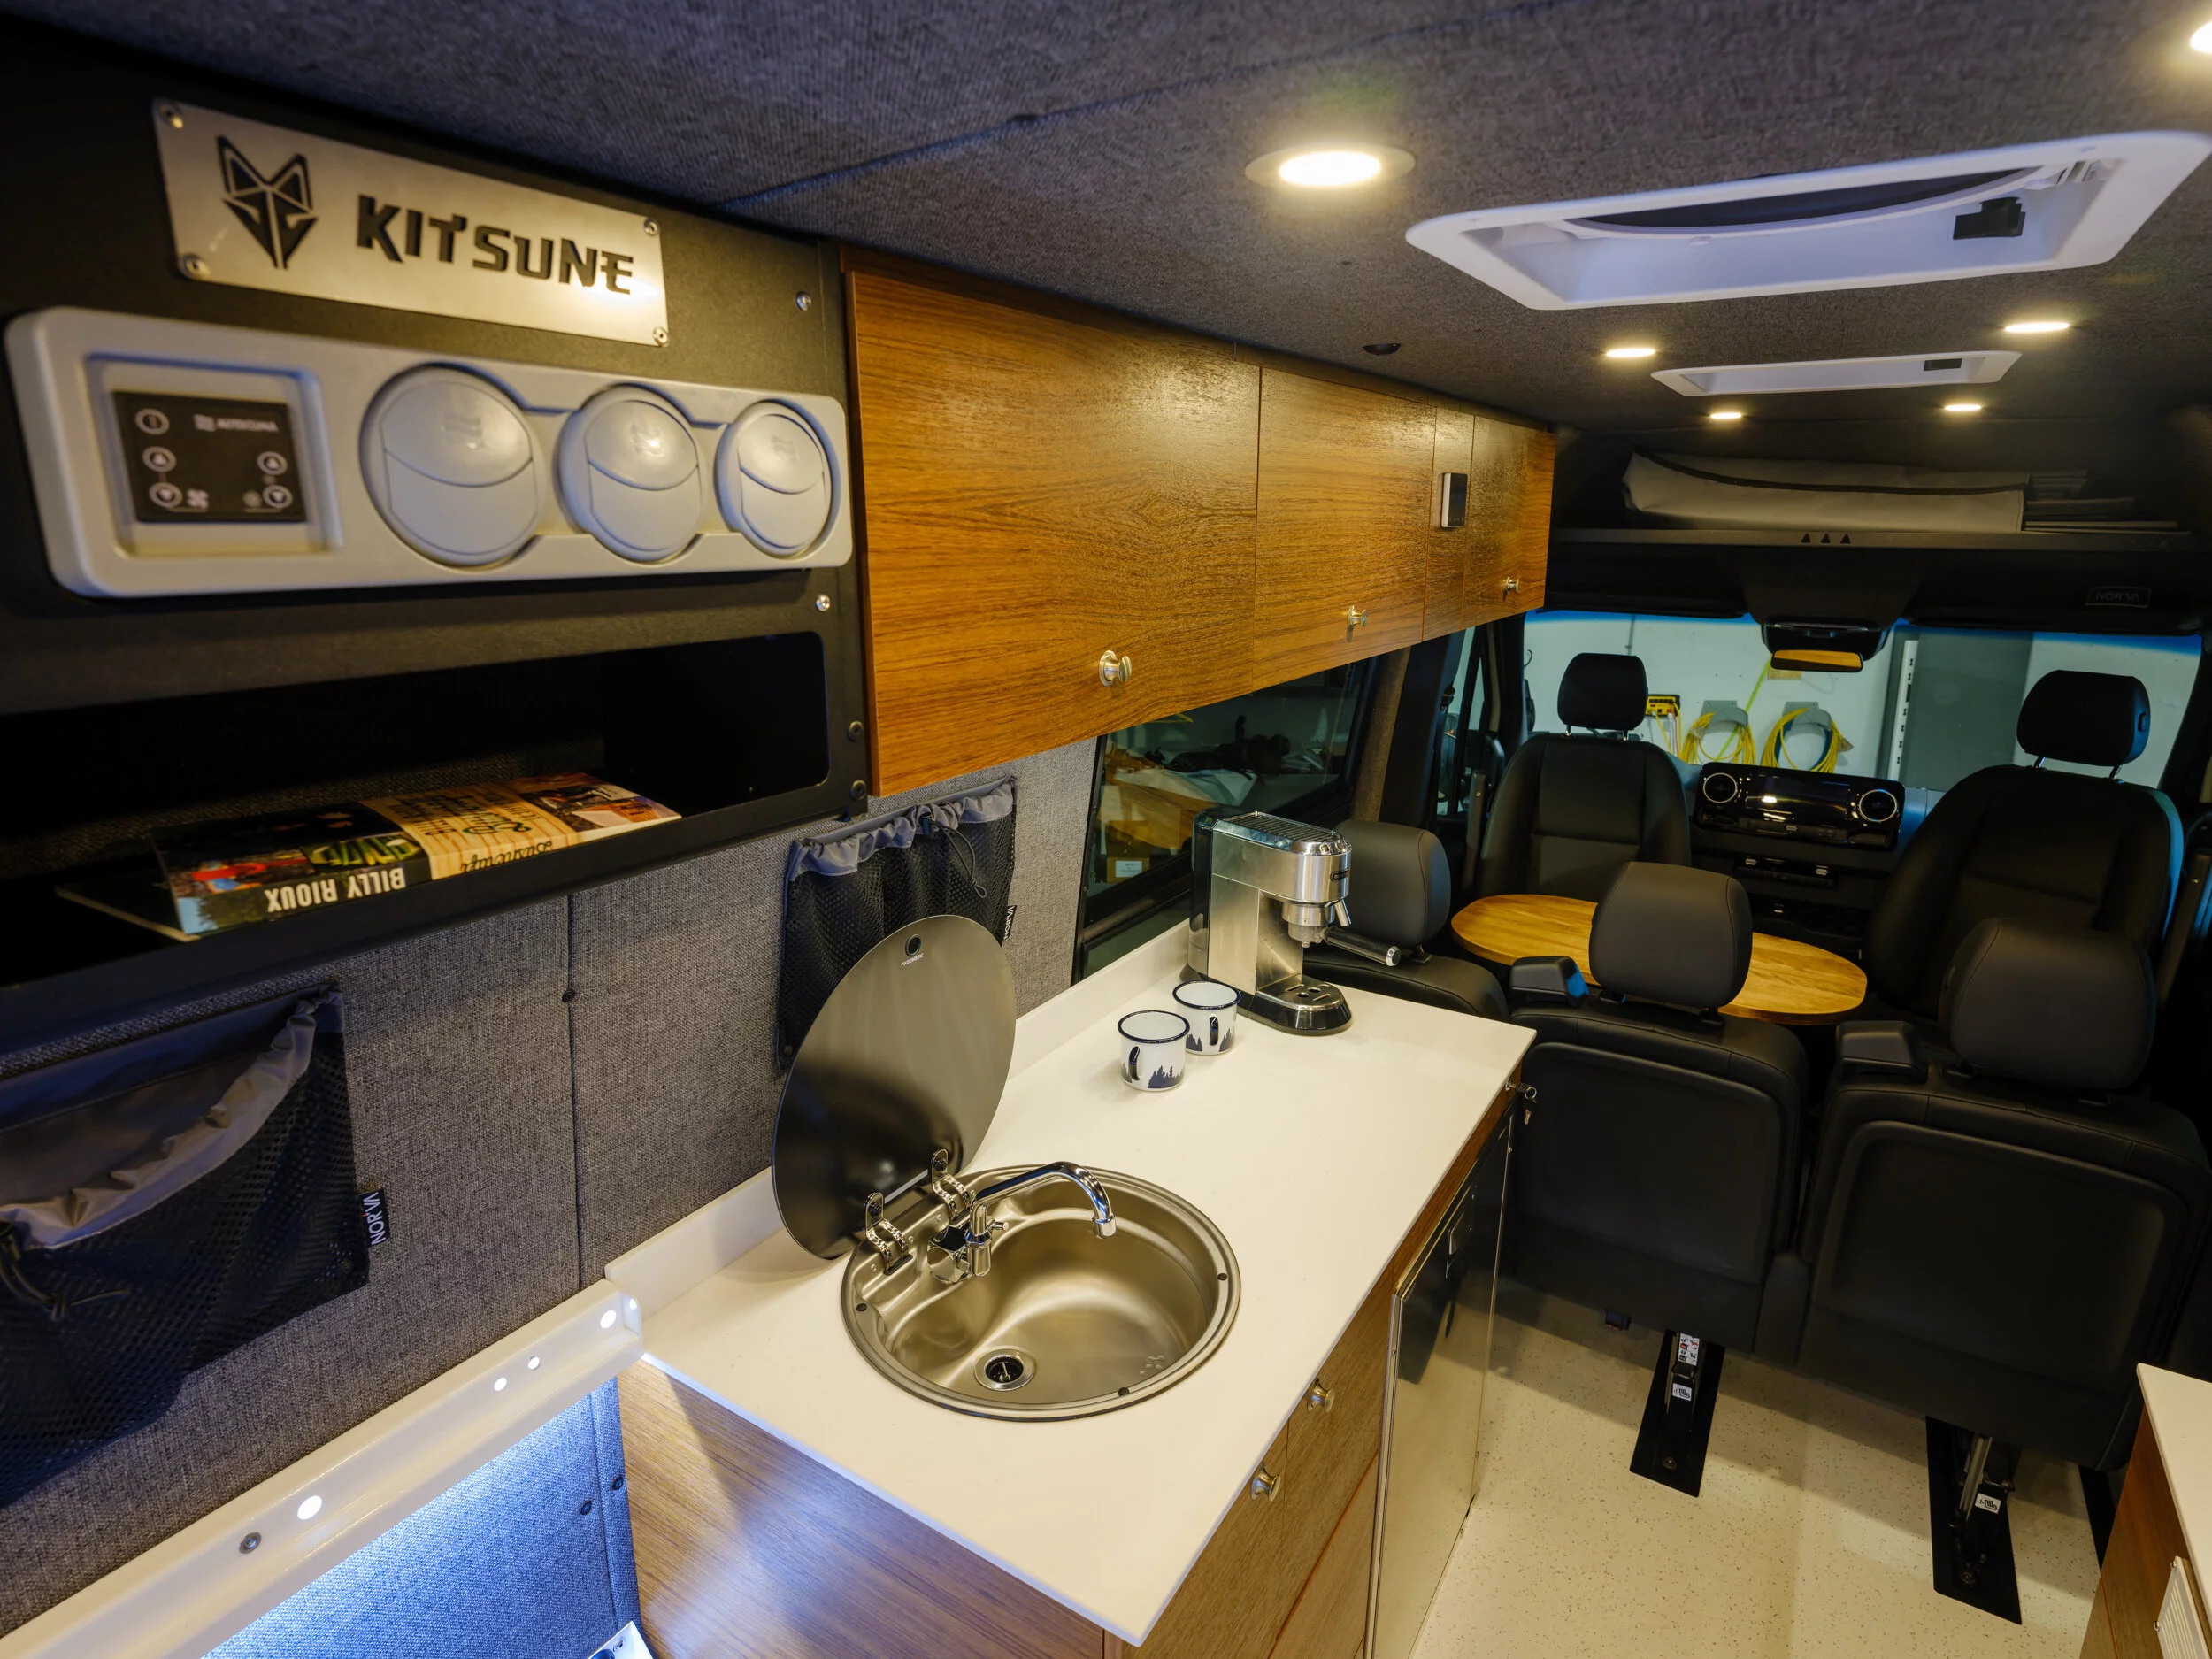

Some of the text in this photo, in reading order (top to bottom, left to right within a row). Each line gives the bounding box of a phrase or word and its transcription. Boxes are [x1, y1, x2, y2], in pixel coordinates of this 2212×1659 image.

[357, 194, 634, 295] KITSUNE
[264, 867, 405, 913] BILLY RIOUX
